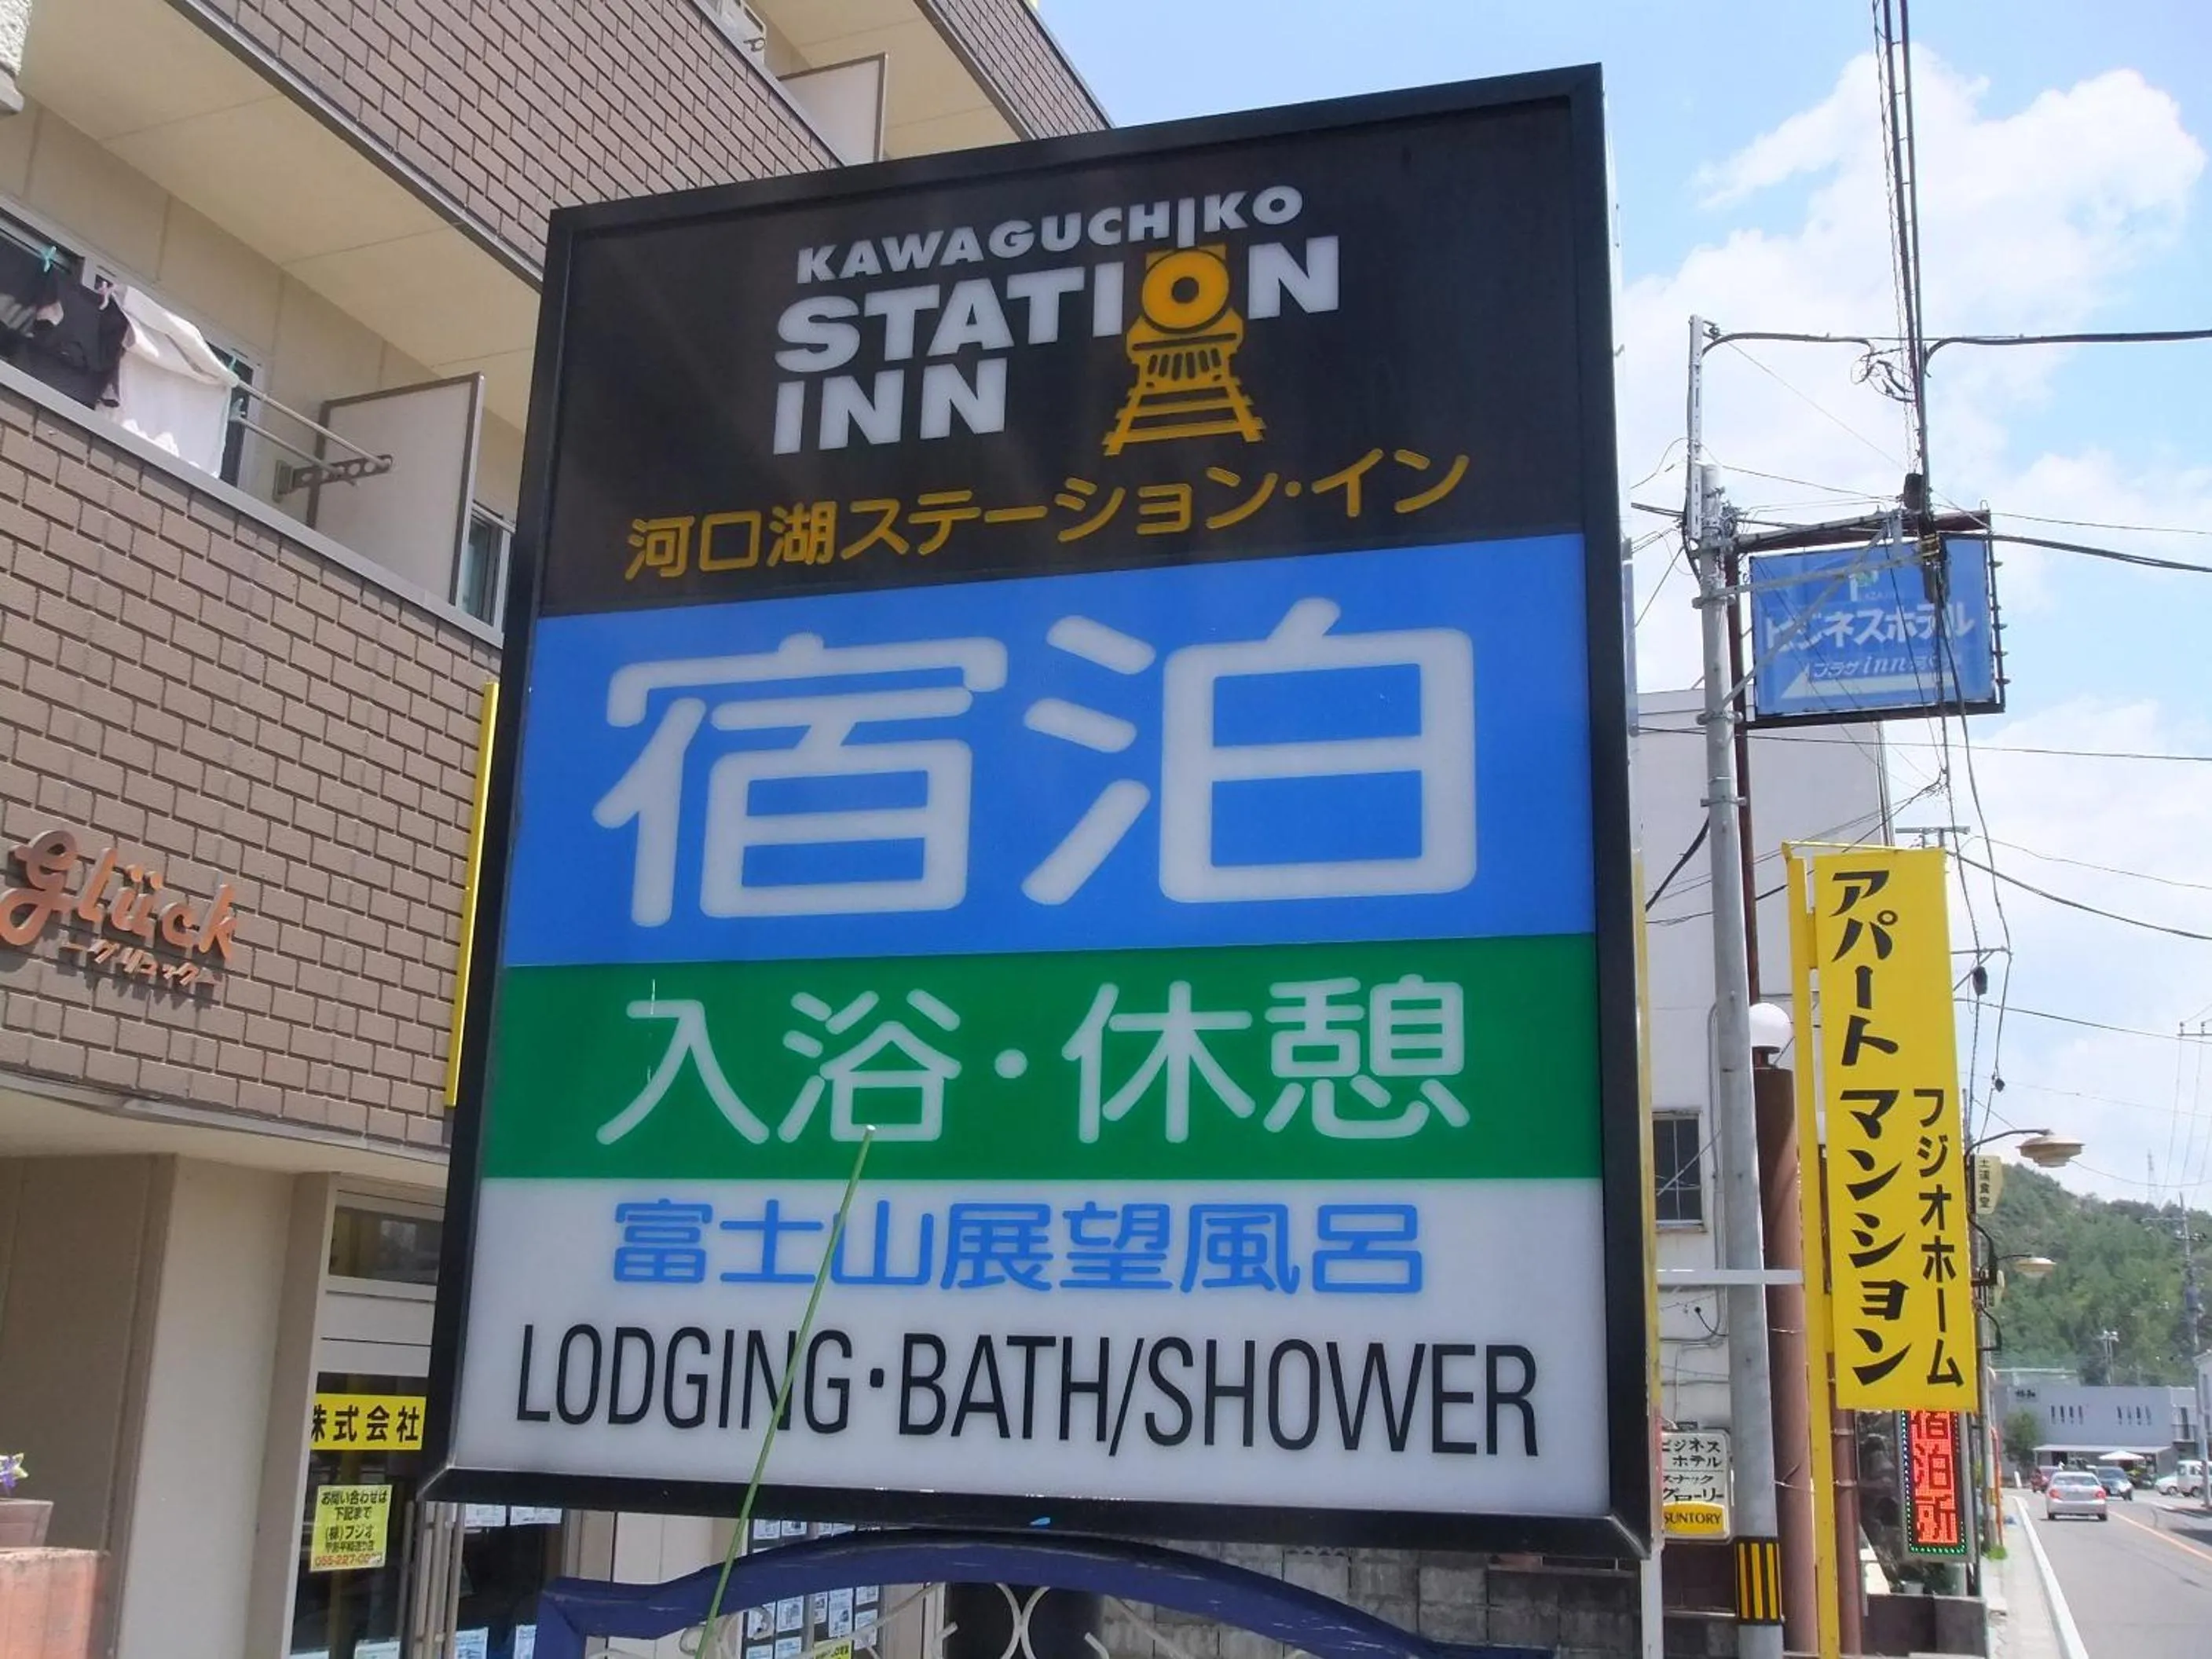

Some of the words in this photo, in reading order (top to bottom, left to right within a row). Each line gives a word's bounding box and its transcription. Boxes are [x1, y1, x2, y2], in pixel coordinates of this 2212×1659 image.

[797, 185, 1303, 284] KAWAGUCHIKO
[775, 235, 1340, 373] STATION
[773, 357, 1007, 456] INN
[626, 449, 1470, 580] 河口湖ステーション・イン
[592, 598, 1478, 928] 宿泊
[0, 830, 236, 961] Glück
[595, 974, 1470, 1145] 入浴・休憩
[613, 1198, 1424, 1295] 富士山展望風呂
[1913, 1089, 1964, 1387] フジオホーム
[320, 1489, 387, 1505] お問い合わせは
[1664, 1511, 1721, 1525] SUNTORY
[1673, 1455, 1721, 1467] ホテル
